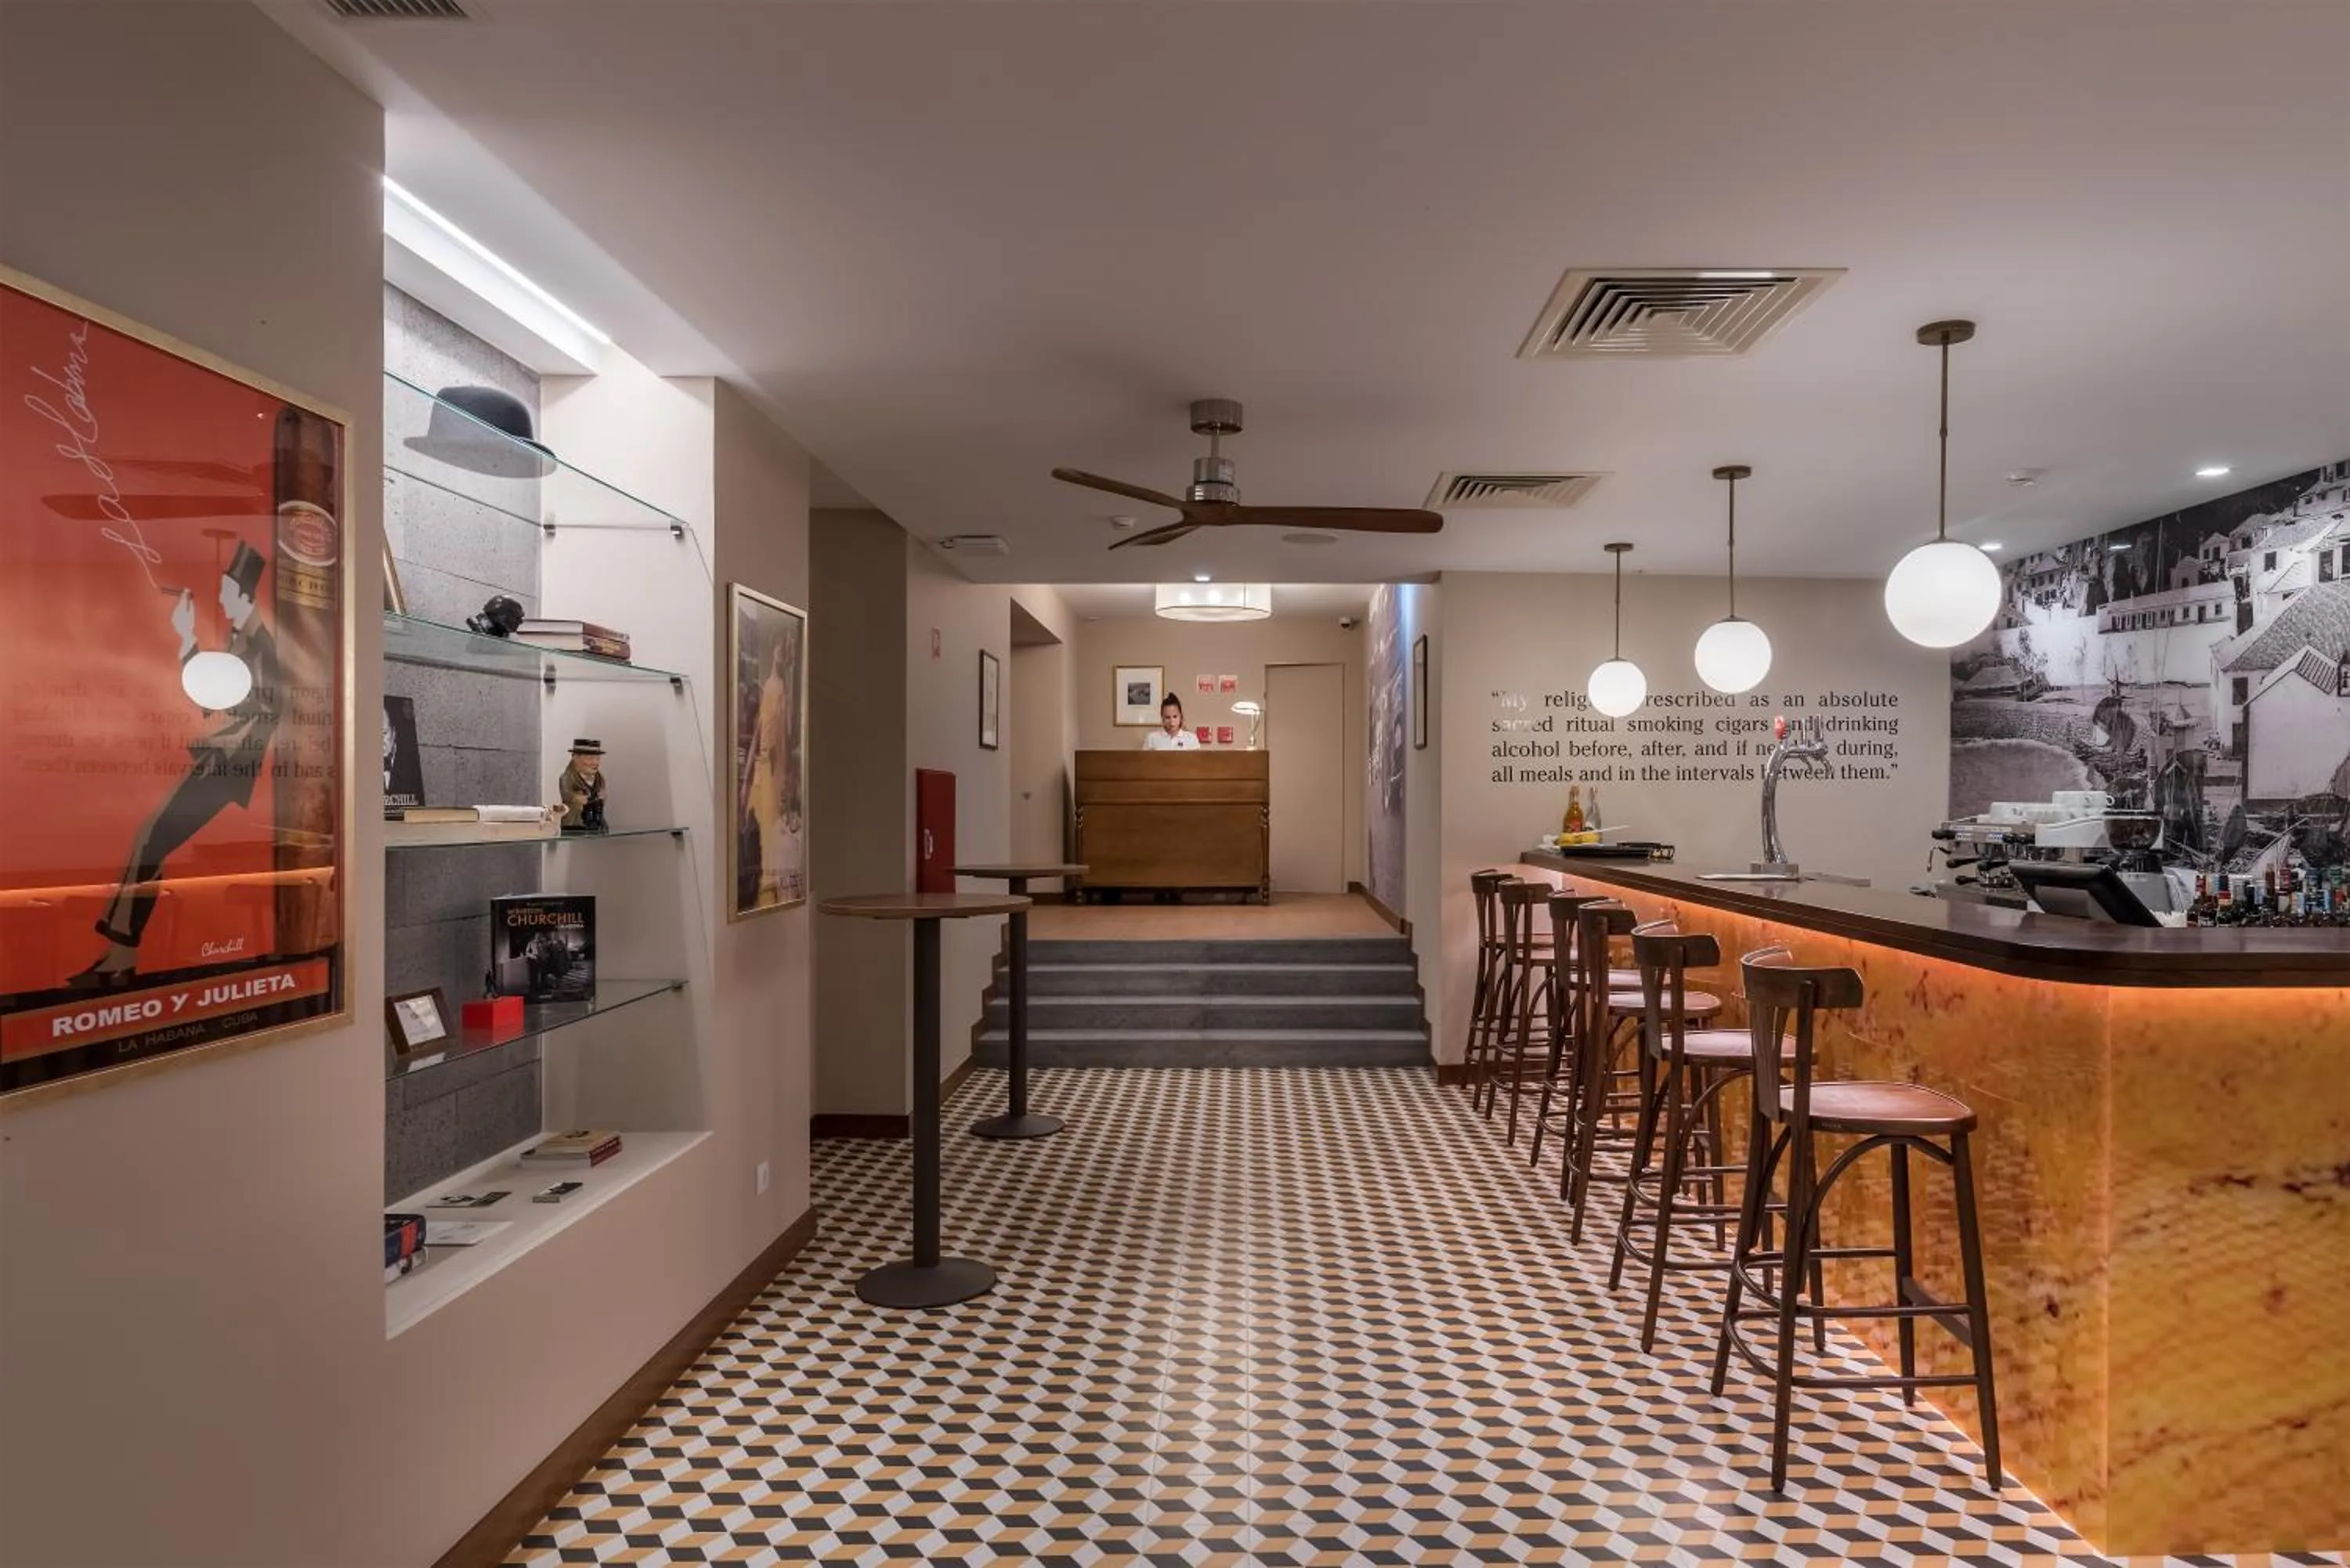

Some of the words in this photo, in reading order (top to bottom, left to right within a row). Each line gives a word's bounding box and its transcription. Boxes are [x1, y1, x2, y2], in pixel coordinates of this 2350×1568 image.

[1544, 691, 1589, 711] relig
[1646, 691, 1736, 706] rescribed
[1750, 693, 1770, 706] as
[1784, 693, 1805, 706] an
[1818, 691, 1899, 707] absolute
[1567, 716, 1614, 732] ritual
[1627, 715, 1705, 735] smoking
[1715, 716, 1769, 735] cigars
[1782, 716, 1813, 731] nd
[1826, 716, 1899, 735] drinking
[1491, 740, 1560, 757] alcohol
[1569, 740, 1632, 758] before,
[1641, 740, 1686, 757] after,
[1694, 740, 1727, 756] and
[1737, 739, 1748, 756] if
[1755, 739, 1798, 756] ne
[1837, 740, 1899, 758] during,
[1491, 765, 1513, 782] all
[1520, 765, 1573, 782] meals
[1579, 765, 1612, 782] and
[1619, 765, 1635, 781] in
[1641, 764, 1671, 781] the
[1676, 764, 1755, 781] intervals
[507, 912, 584, 927] CHURCHILL
[201, 938, 245, 957] Churchill
[52, 999, 163, 1037] ROMEO
[169, 992, 190, 1012] Y
[197, 974, 296, 1007] JULIETA
[118, 1038, 139, 1053] LA
[146, 1022, 207, 1046] HABANA
[221, 1011, 259, 1029] CUBA
